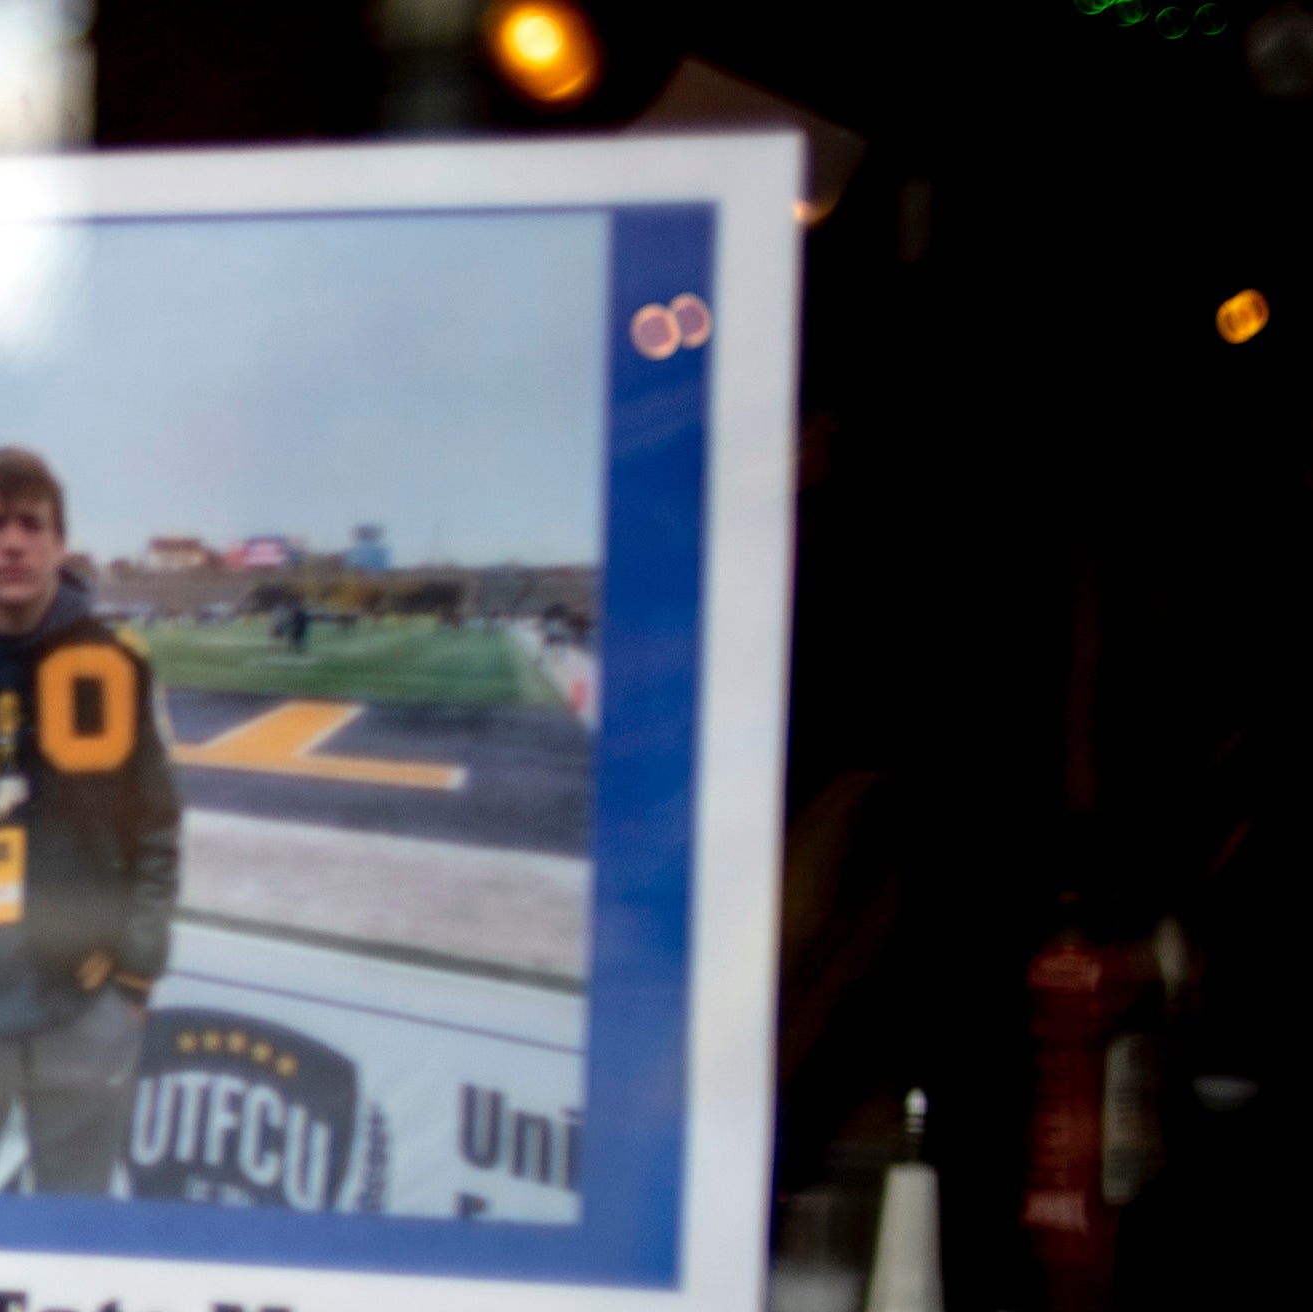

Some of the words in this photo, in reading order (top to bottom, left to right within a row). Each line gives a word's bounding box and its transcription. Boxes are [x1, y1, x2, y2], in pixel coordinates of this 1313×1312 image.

[36, 642, 138, 774] O
[131, 1070, 331, 1215] UTFCU
[457, 1083, 582, 1192] Uni
